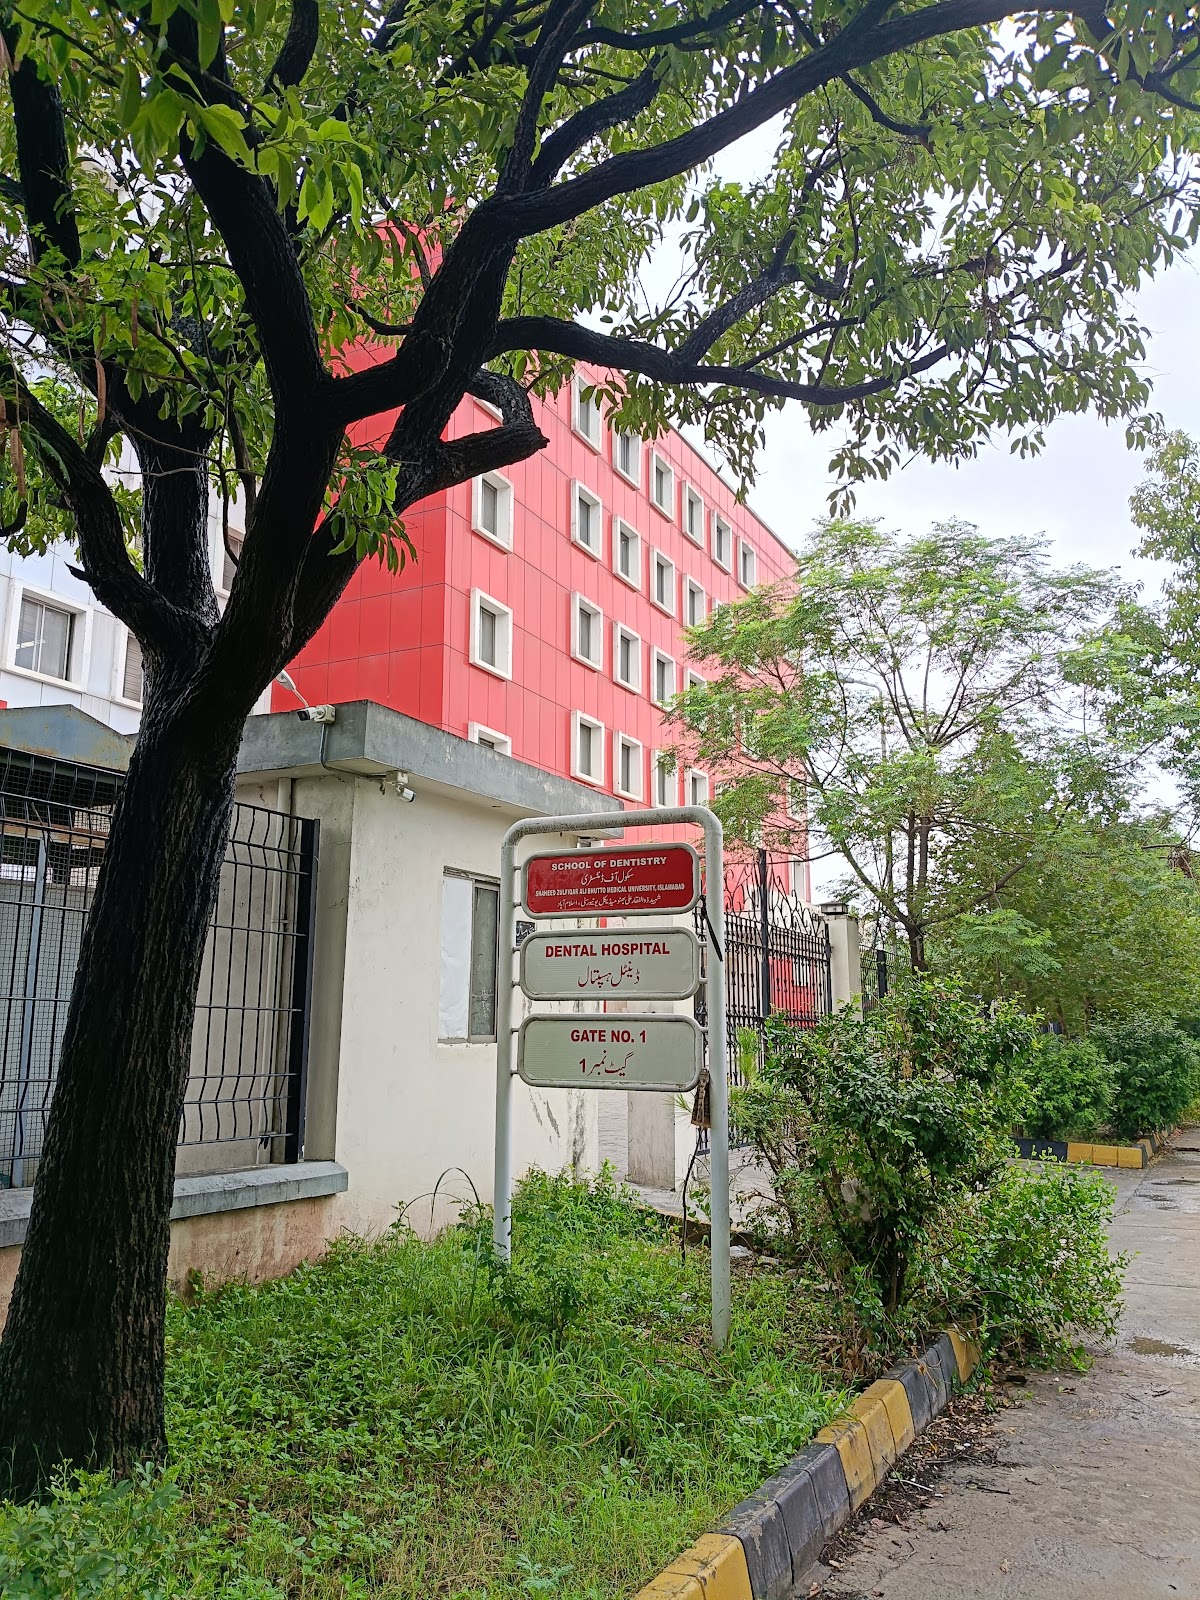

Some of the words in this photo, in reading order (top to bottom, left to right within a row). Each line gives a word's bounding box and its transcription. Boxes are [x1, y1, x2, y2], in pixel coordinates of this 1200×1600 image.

[551, 861, 592, 871] SCHOOL
[594, 860, 607, 869] OF
[610, 856, 667, 867] DENTISTRY
[604, 870, 619, 883] آف
[617, 868, 634, 883] سکول
[535, 889, 556, 897] SHAHEED
[557, 888, 579, 896] ZULFIQAR
[628, 884, 656, 893] UNIVERSITY,
[657, 883, 685, 891] ISLAMABAD
[545, 945, 597, 957] DENTAL
[601, 942, 670, 956] HOSPITAL
[578, 965, 611, 988] ہسپتال
[611, 961, 640, 987] ڈینٹل
[570, 1029, 606, 1043] GATE
[611, 1030, 635, 1043] NO.
[639, 1030, 646, 1043] 1
[579, 1058, 586, 1073] 1
[587, 1050, 607, 1076] نمبر
[605, 1051, 635, 1077] گیٹ
